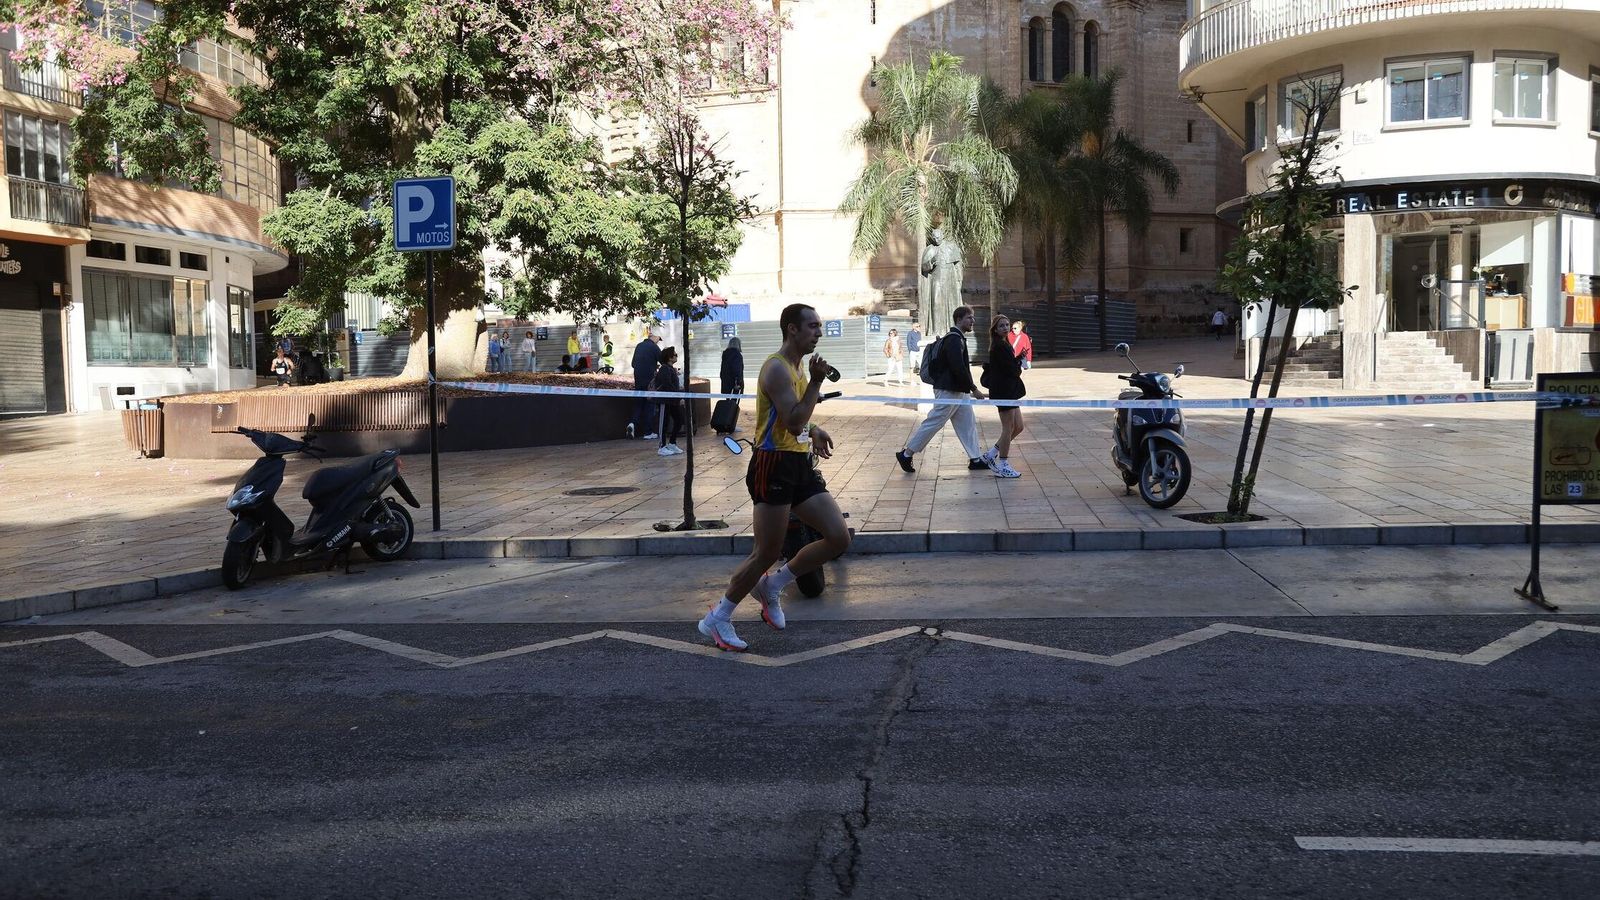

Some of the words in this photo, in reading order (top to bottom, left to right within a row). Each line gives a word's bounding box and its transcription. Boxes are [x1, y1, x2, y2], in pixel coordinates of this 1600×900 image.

[1336, 193, 1386, 214] REAL
[1397, 190, 1474, 209] ESTATE
[397, 185, 434, 242] P
[417, 231, 450, 243] MOTOS
[1544, 470, 1594, 482] PROHIBIDO
[1568, 485, 1581, 494] 23
[331, 524, 352, 543] YAMAHA
